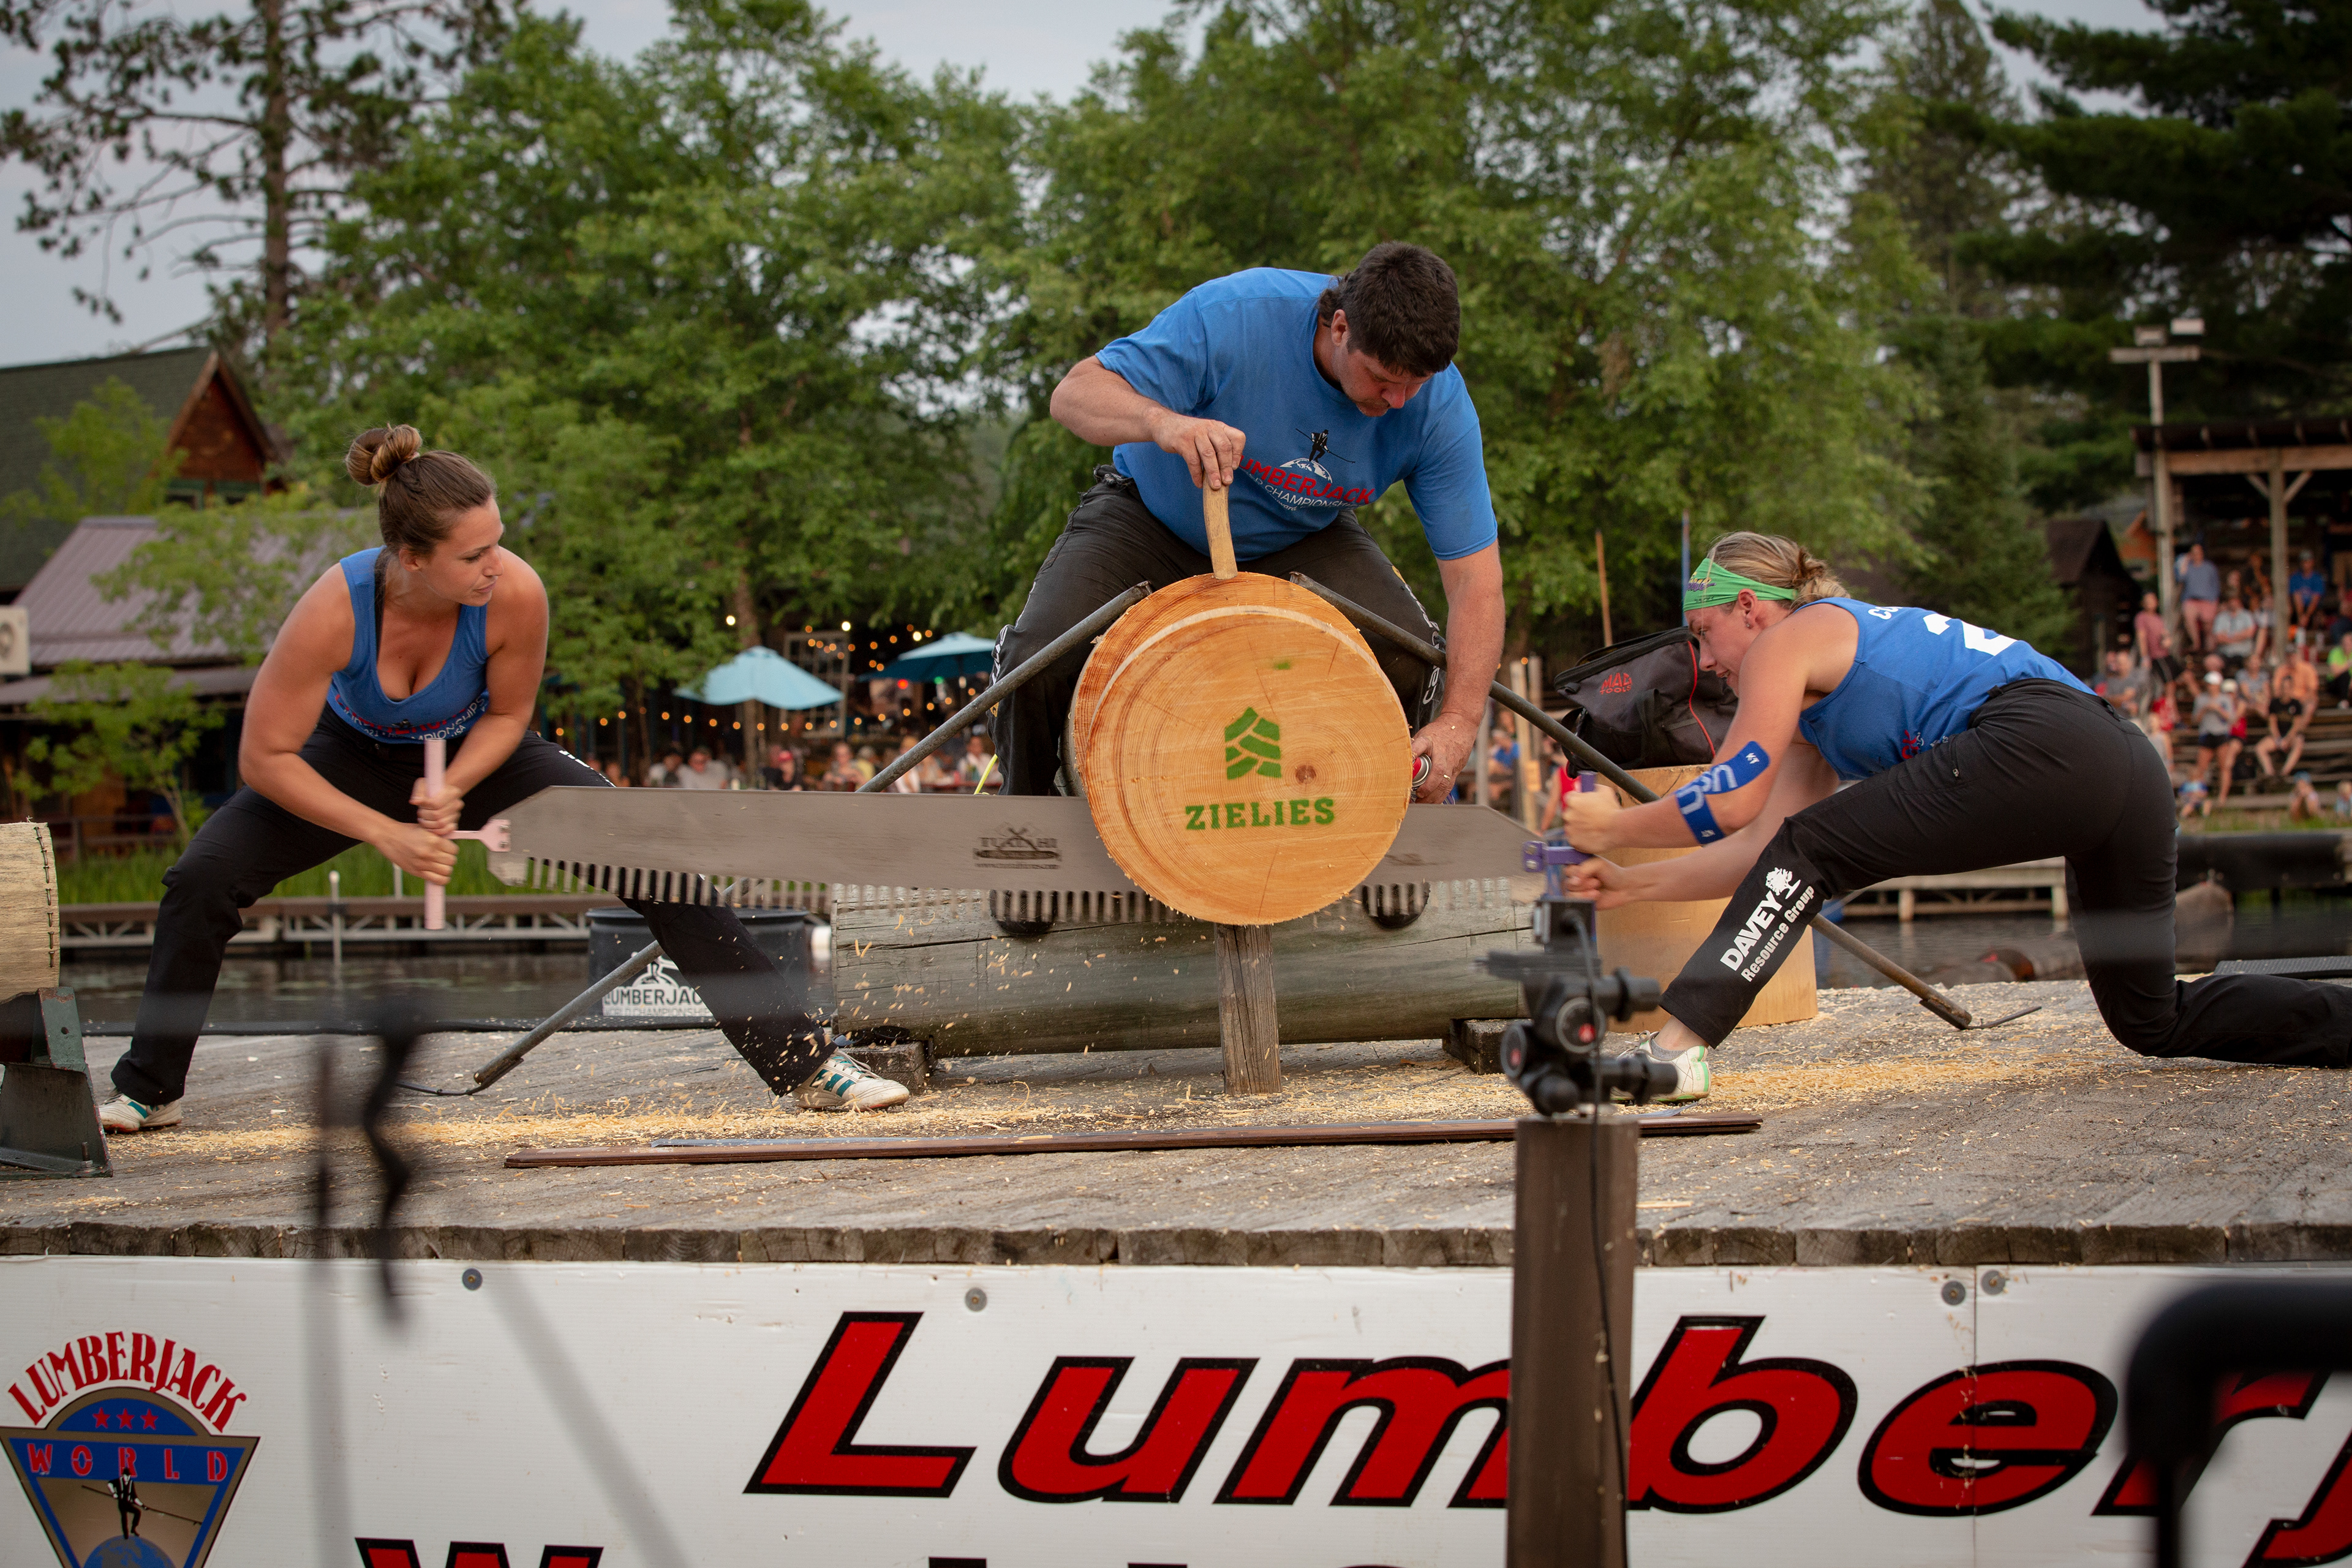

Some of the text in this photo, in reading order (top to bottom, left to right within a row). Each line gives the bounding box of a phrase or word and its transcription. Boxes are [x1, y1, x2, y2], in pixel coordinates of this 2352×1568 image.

[1238, 454, 1376, 505] UMBERJACK
[1599, 684, 1632, 695] TOOLS
[1185, 797, 1335, 831] ZIELIES
[1719, 890, 1783, 971] DAVEY
[1741, 885, 1815, 982] Resource Group
[603, 989, 703, 1005] LUMBERJAC
[633, 1007, 710, 1016] CHAMPIONSHIP
[7, 1331, 247, 1433] LUMBERJACK
[26, 1442, 228, 1482] WORLD
